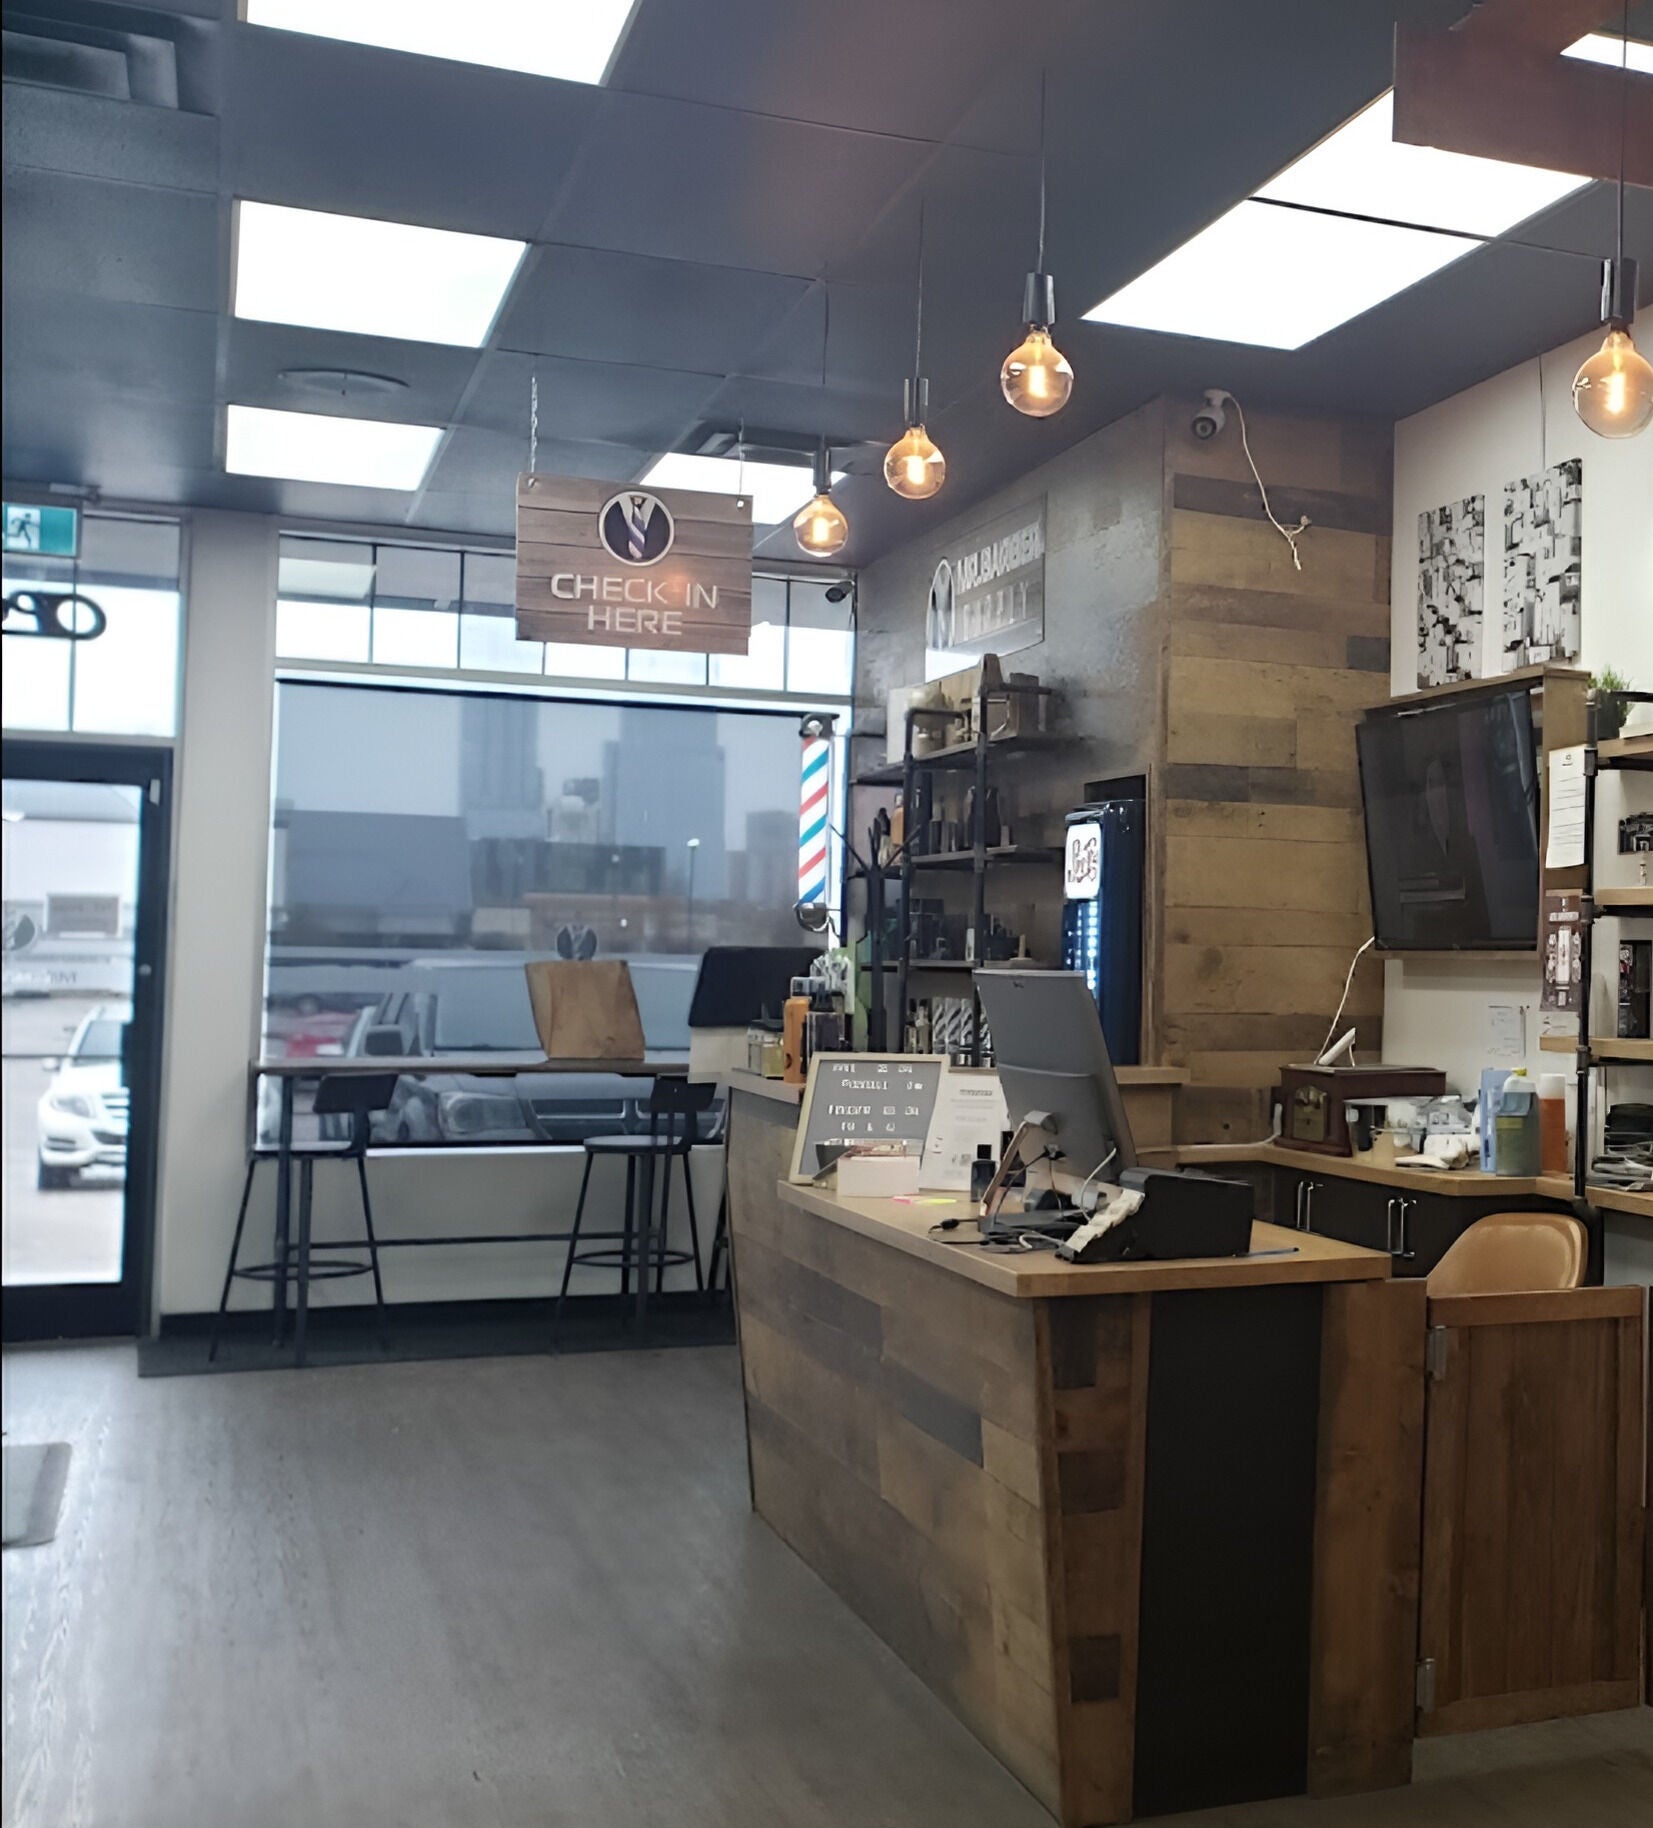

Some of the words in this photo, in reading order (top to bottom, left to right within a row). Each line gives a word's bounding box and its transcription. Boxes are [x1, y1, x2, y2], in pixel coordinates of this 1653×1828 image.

[551, 574, 668, 604] CHECK
[685, 582, 718, 609] IN
[588, 605, 683, 635] HERE
